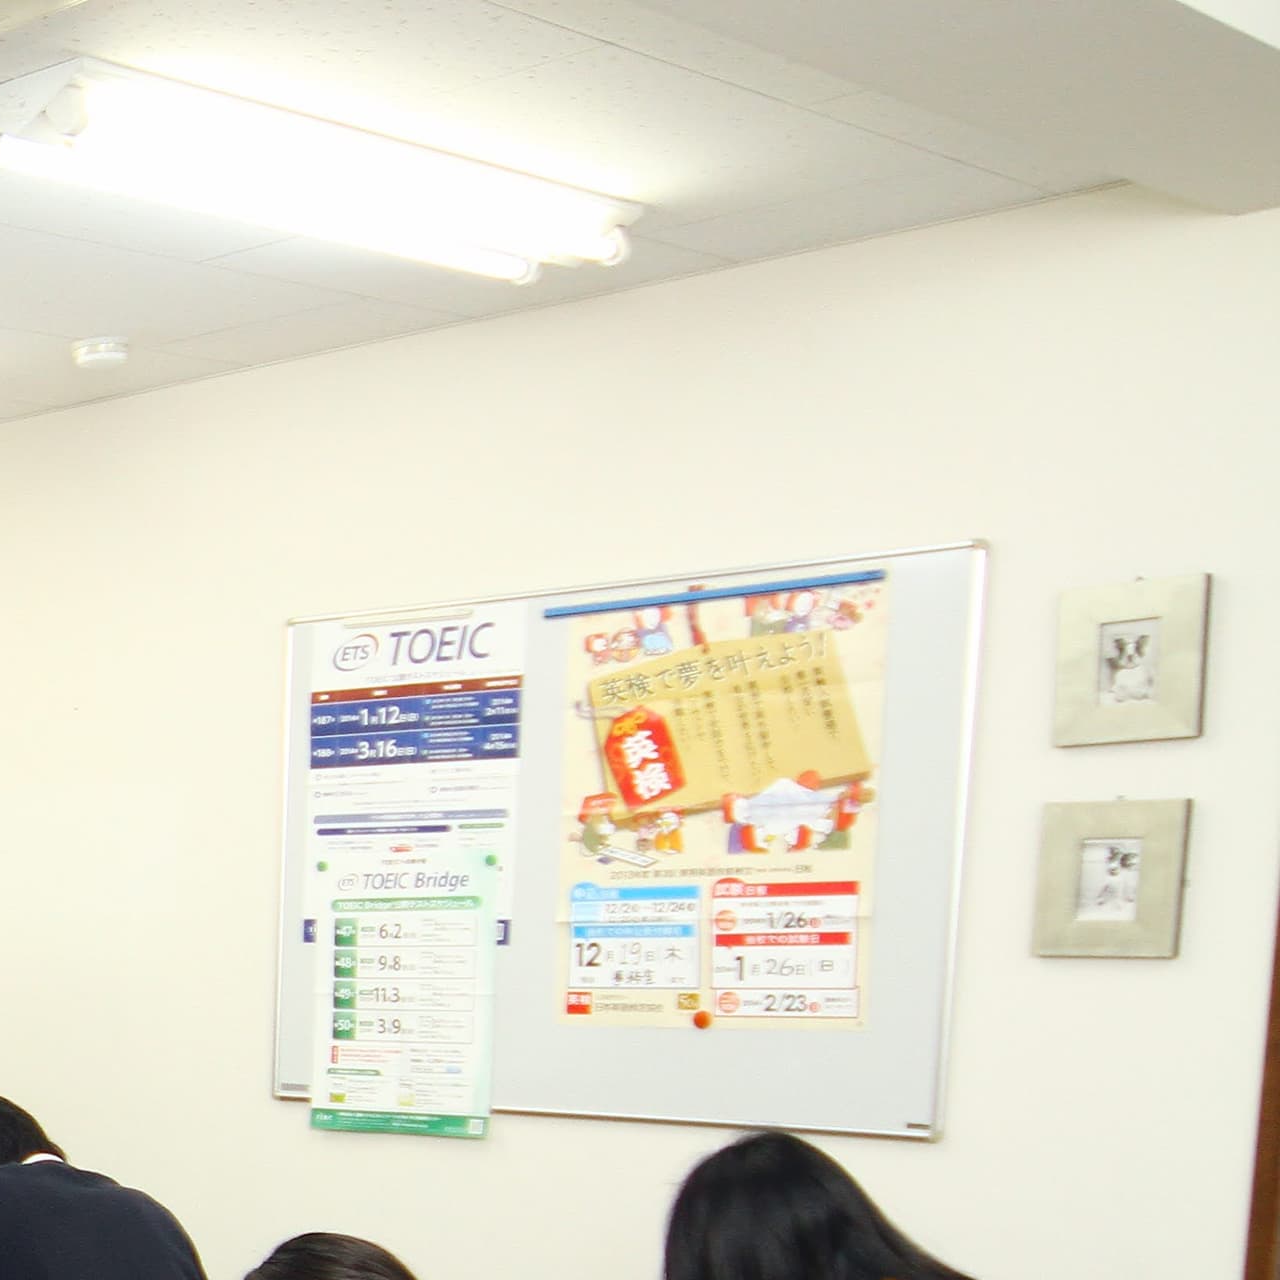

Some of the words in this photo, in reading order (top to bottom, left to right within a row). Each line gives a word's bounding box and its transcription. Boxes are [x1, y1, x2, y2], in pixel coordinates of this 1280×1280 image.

[341, 644, 371, 663] ETS
[389, 622, 497, 667] TOEIC
[622, 729, 673, 800] 英検
[362, 872, 410, 890] TOEIC
[414, 870, 471, 892] Bridge
[575, 942, 602, 967] 12
[765, 958, 794, 977] 26
